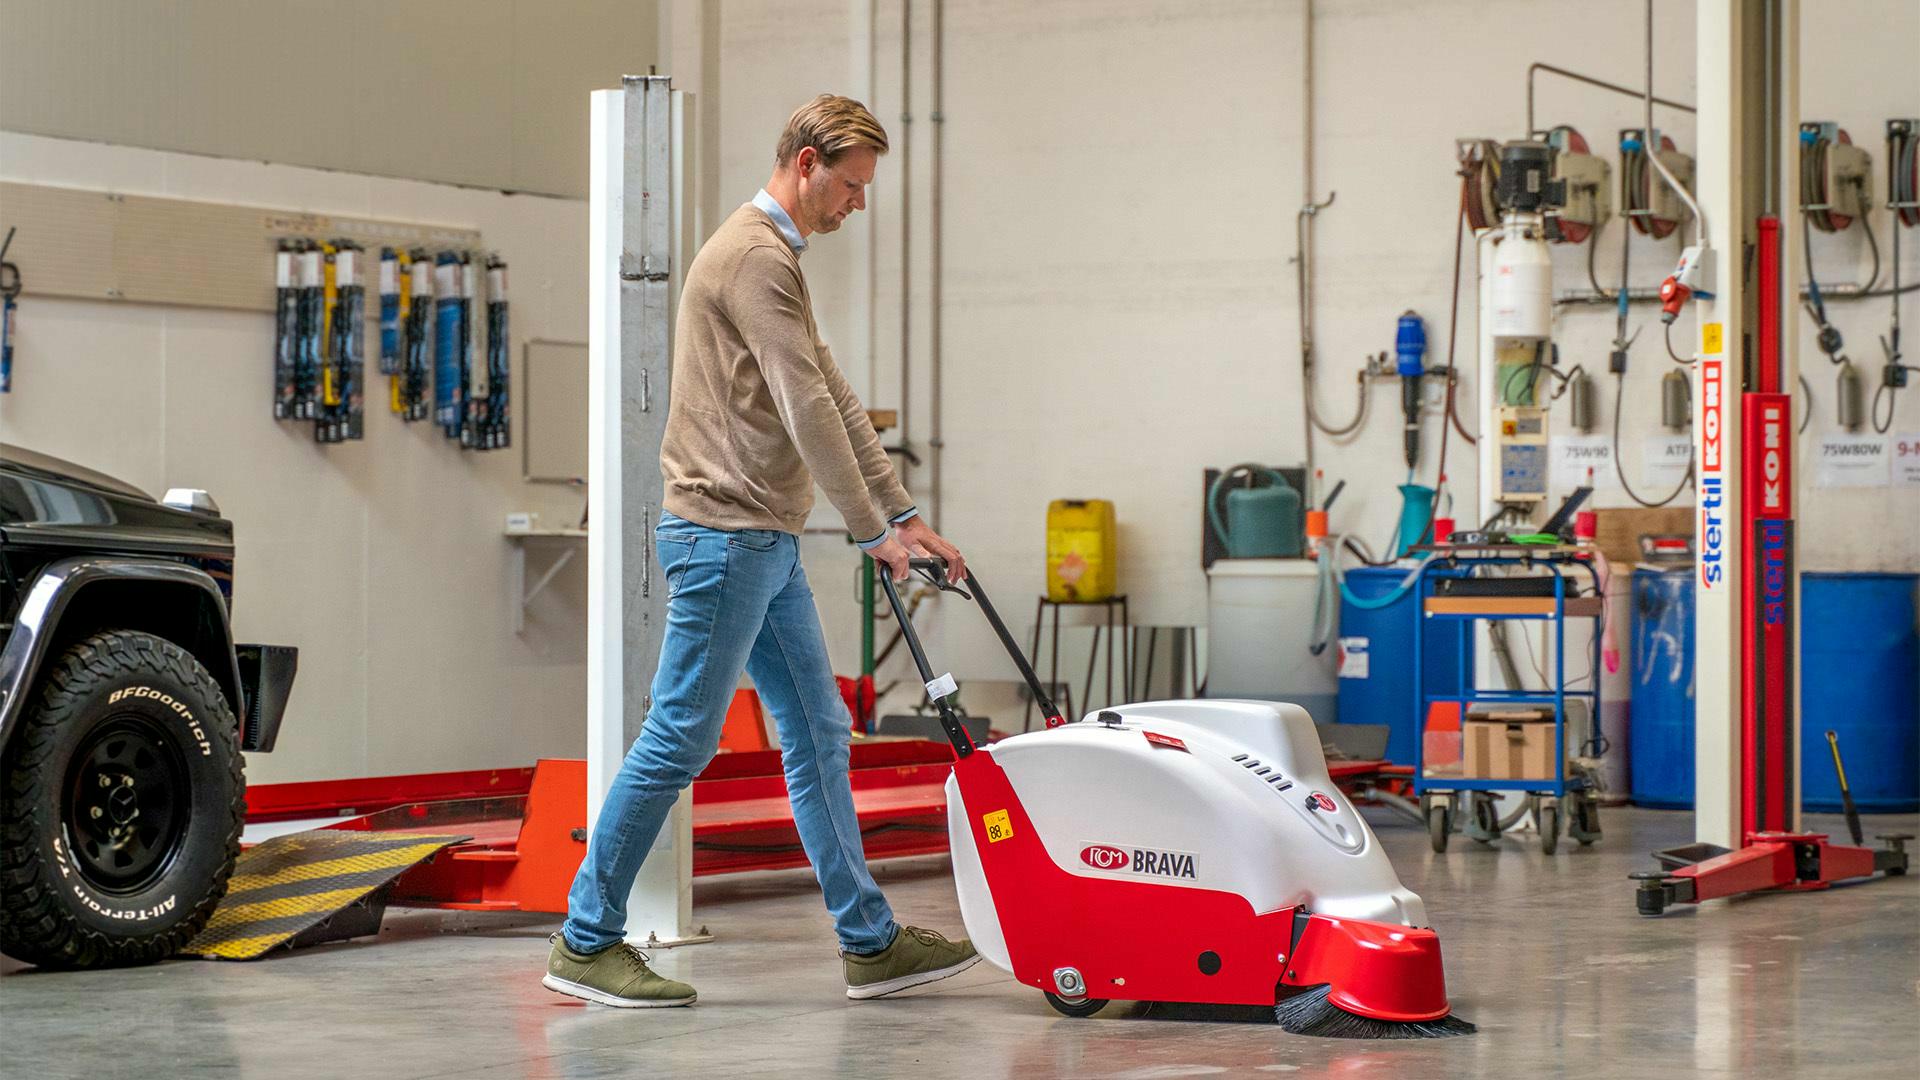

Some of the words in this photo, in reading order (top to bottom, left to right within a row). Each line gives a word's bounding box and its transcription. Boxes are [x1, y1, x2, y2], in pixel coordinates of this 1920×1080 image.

[1705, 366, 1719, 466] KONI
[1566, 446, 1609, 458] 75W90
[1764, 408, 1780, 507] KONI
[1702, 478, 1722, 583] stertil
[107, 686, 212, 756] BFGoodrich
[1132, 849, 1196, 879] BRAVA
[73, 885, 176, 920] All-Terrain
